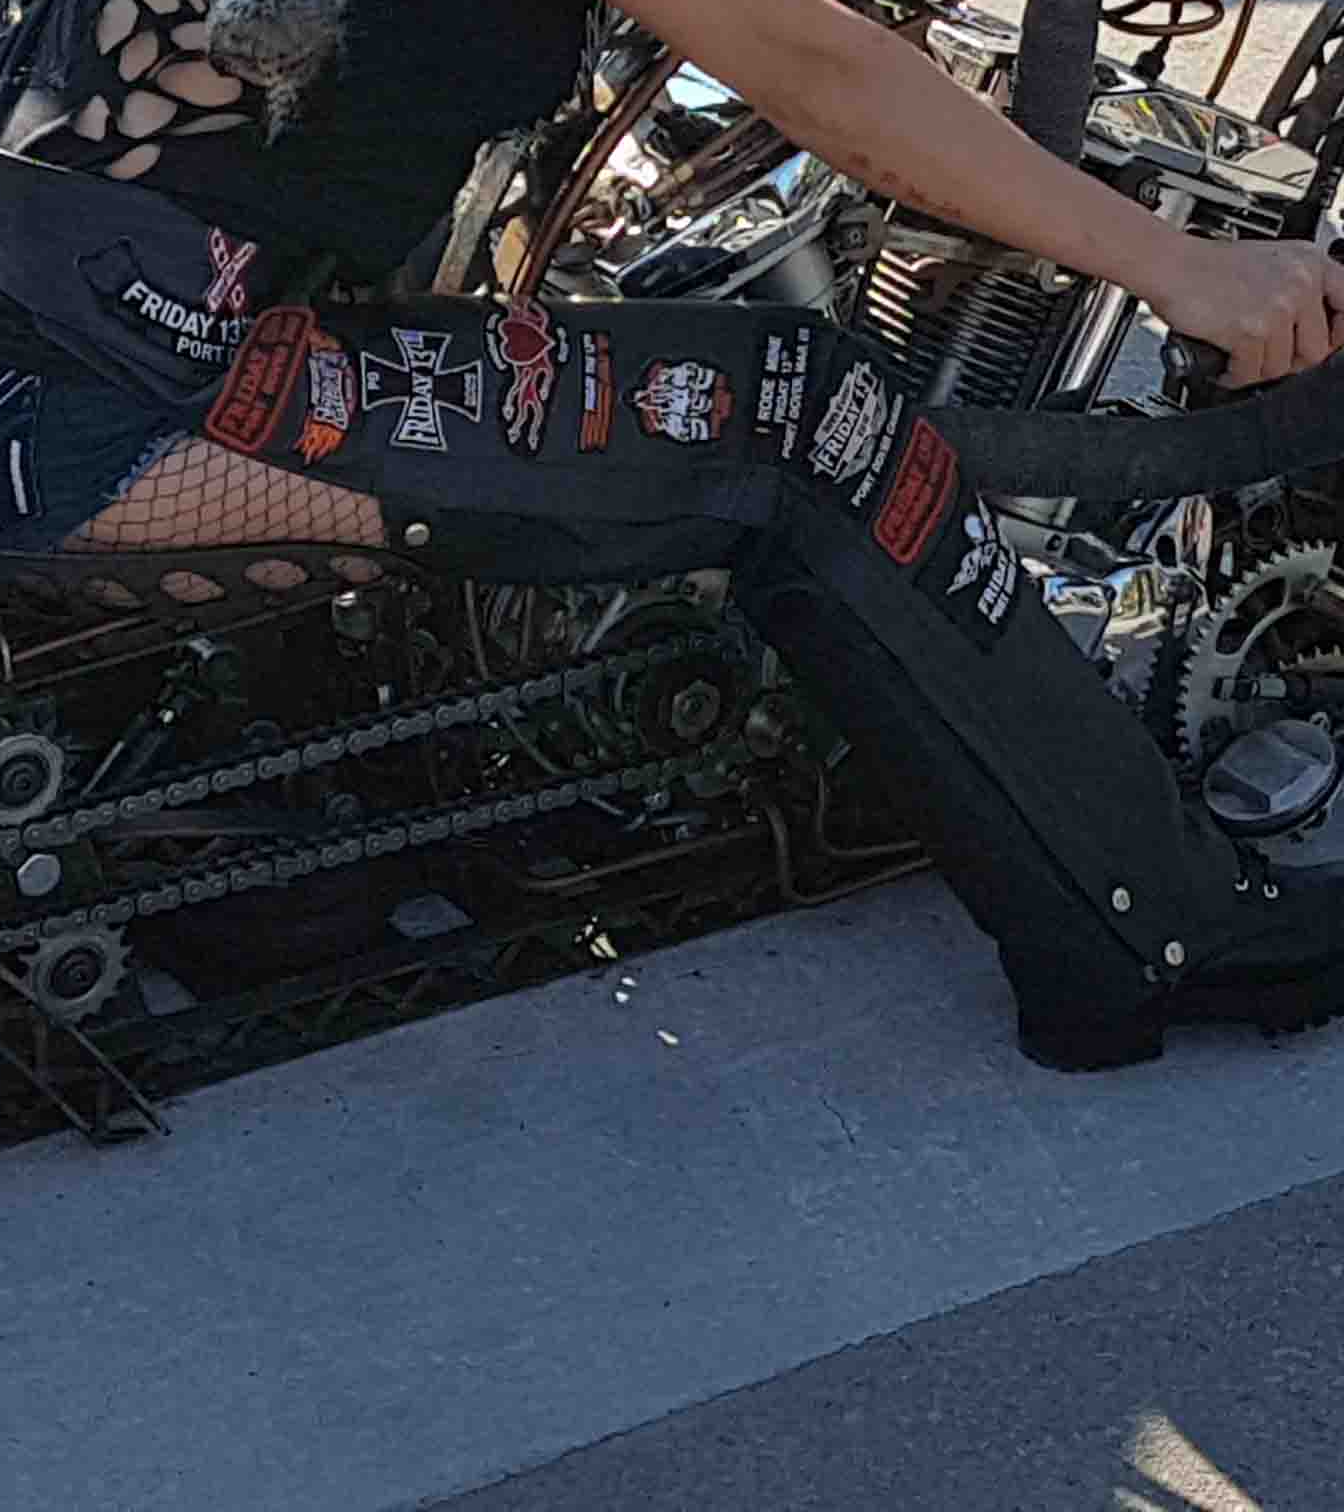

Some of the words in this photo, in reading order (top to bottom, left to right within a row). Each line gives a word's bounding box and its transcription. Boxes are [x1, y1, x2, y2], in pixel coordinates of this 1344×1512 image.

[121, 279, 215, 339] FRIDAY
[175, 336, 226, 362] PORT
[397, 372, 440, 444] FRIDAY
[816, 399, 862, 467] FRIDAY
[850, 471, 876, 507] PORT
